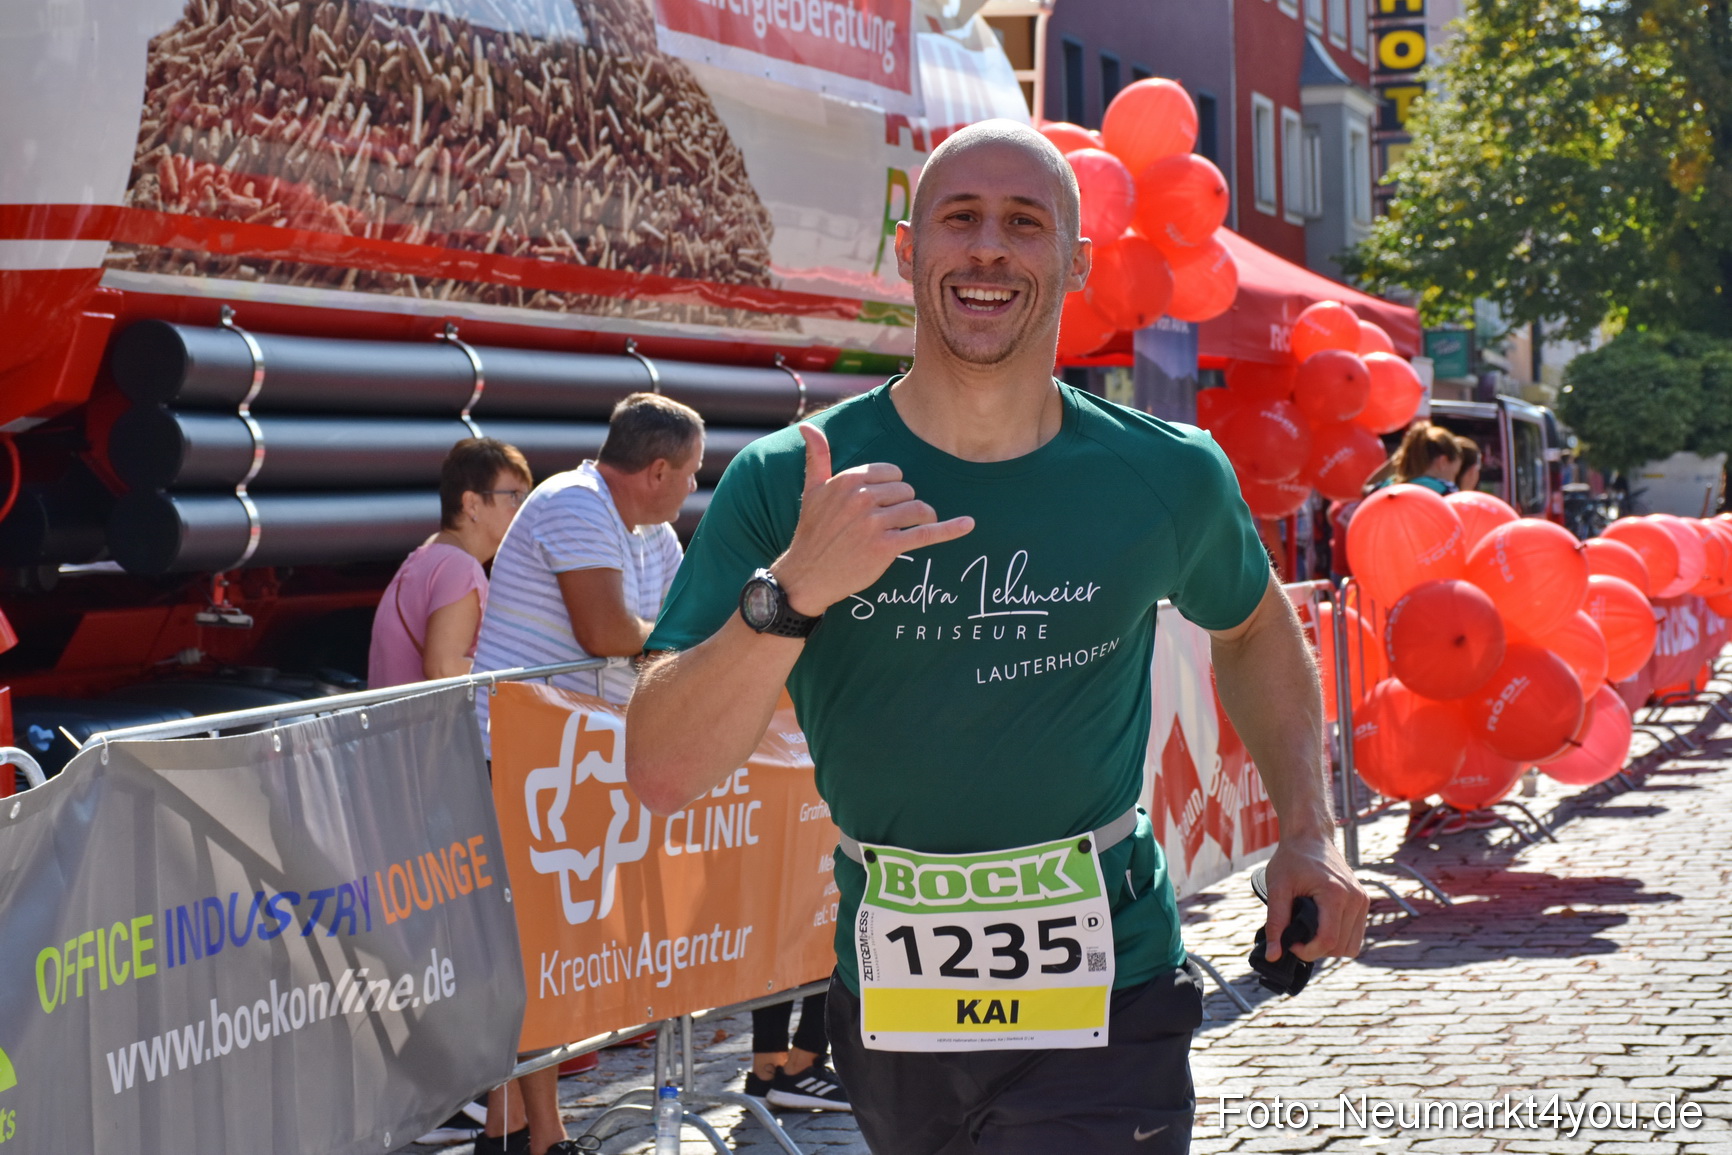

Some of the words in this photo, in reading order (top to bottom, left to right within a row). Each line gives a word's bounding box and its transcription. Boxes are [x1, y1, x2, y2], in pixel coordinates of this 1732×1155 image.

[960, 549, 1101, 618] Lehmeier
[895, 624, 1049, 641] FRISEURE
[976, 637, 1121, 685] LAUTERHOFEN
[664, 799, 763, 857] CLINIC
[881, 849, 1078, 904] BOCK
[35, 914, 157, 1014] OFFICE
[165, 875, 373, 969] INDUSTRY
[375, 834, 494, 925] LOUNGE
[885, 915, 1083, 980] 1235
[1086, 916, 1099, 929] D
[539, 923, 753, 999] KreativAgentur
[106, 948, 457, 1094] www.bockonline.de
[956, 998, 1020, 1025] KAI
